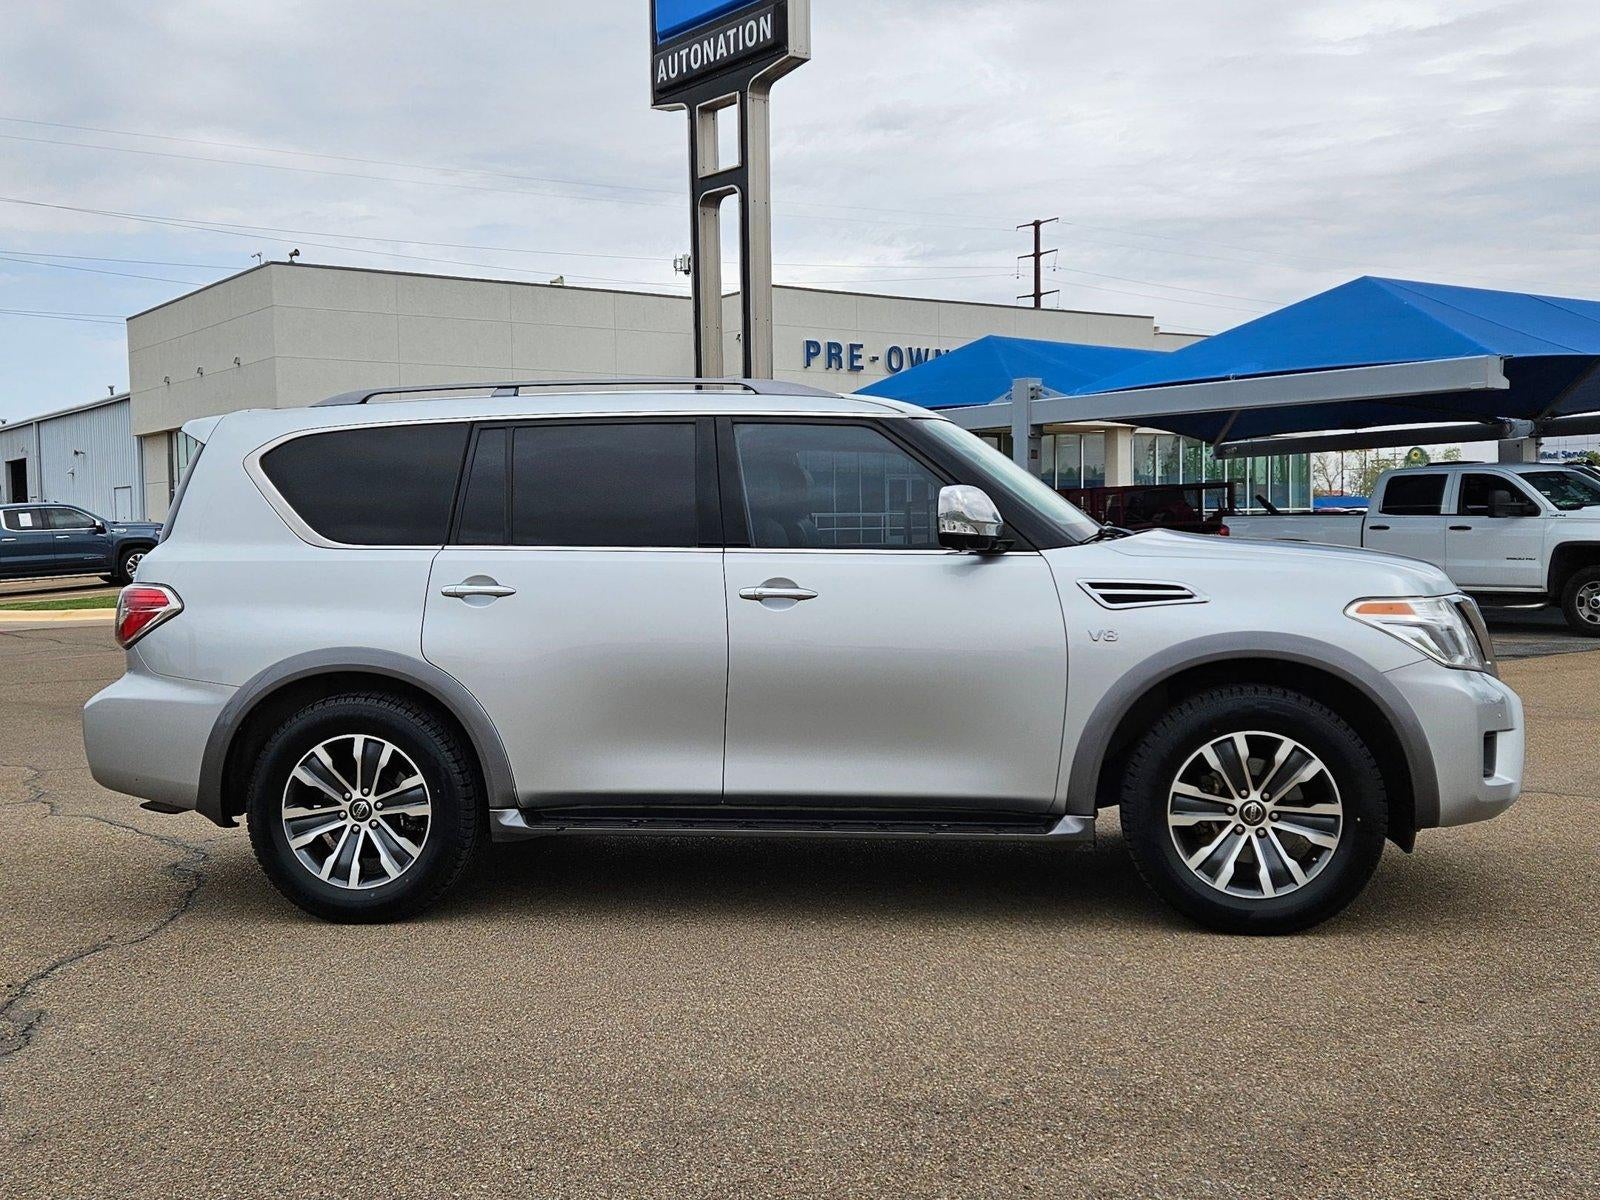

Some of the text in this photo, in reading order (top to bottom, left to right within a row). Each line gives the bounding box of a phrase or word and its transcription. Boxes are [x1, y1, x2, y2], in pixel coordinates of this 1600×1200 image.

[656, 13, 772, 83] AUTONATION
[803, 339, 950, 374] PRE-OW
[1087, 629, 1120, 642] V8
